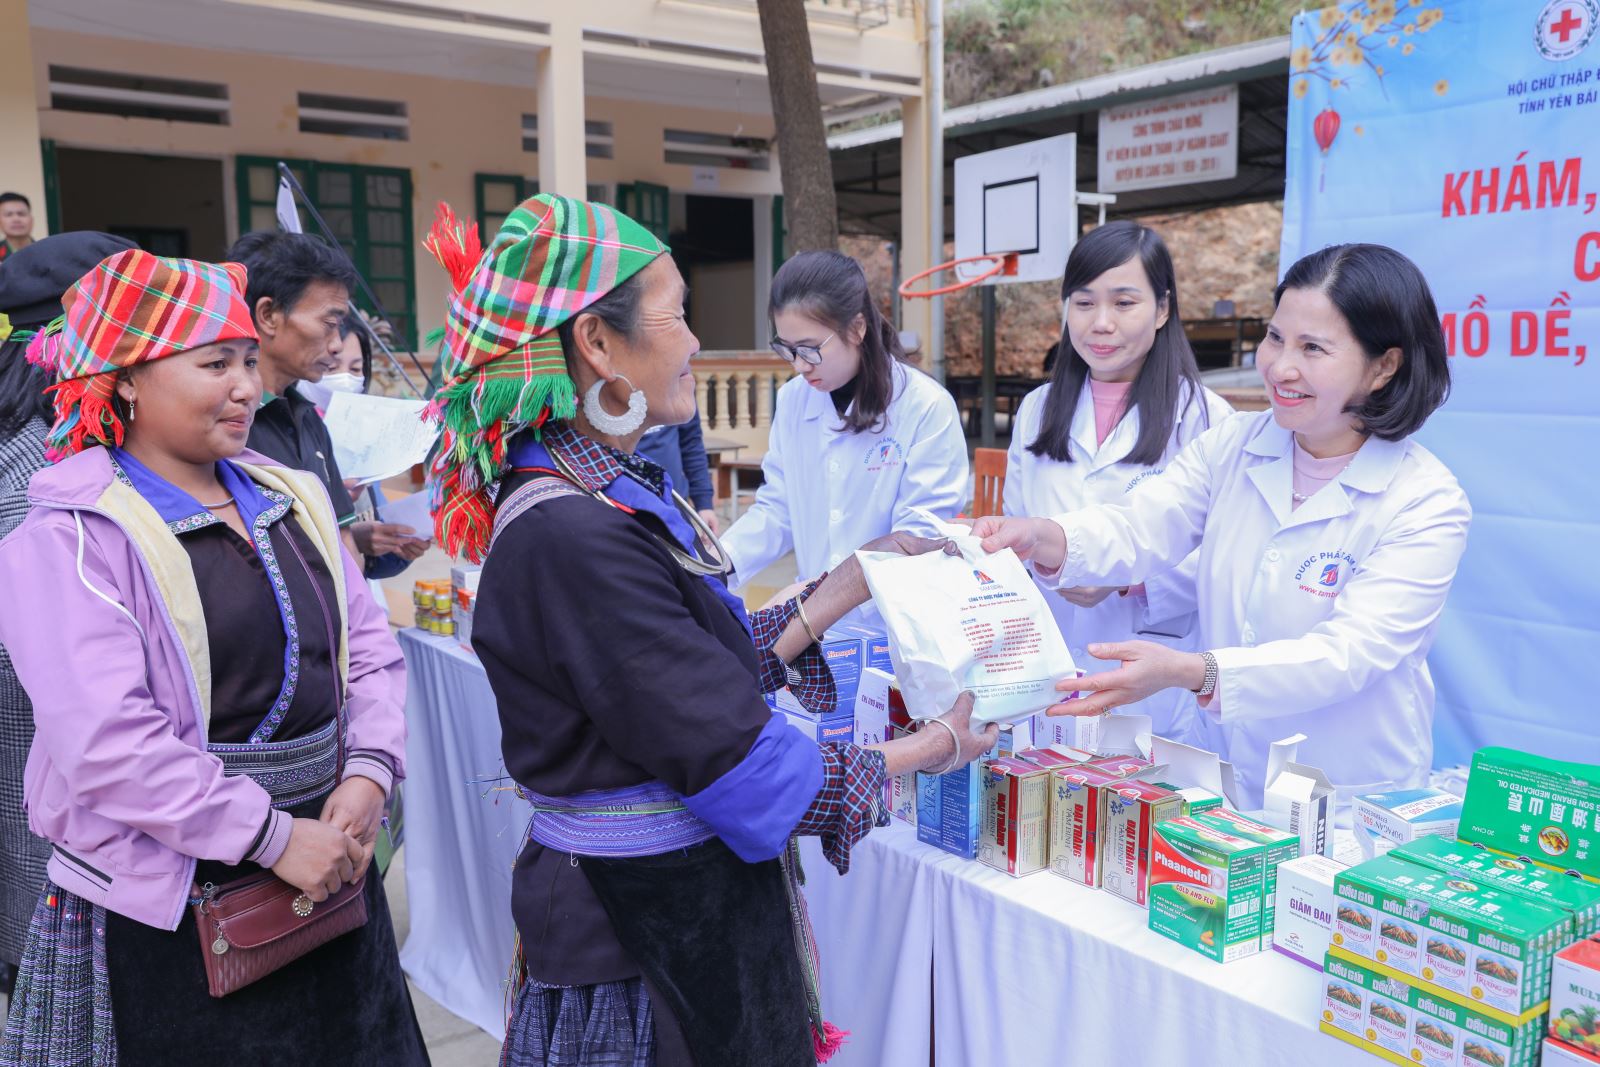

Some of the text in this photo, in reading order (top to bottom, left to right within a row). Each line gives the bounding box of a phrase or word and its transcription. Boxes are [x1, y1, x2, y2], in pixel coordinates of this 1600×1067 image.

[1508, 80, 1527, 97] HỘI
[1531, 74, 1556, 92] CHỮ
[1560, 68, 1592, 88] THẬP
[1549, 93, 1573, 109] YÊN
[1441, 150, 1597, 218] KHÁM,
[1510, 291, 1587, 366] DỀ,
[1073, 803, 1084, 858] ĐẠI TRÀNG
[1125, 819, 1136, 876] ĐẠI TRÀNG
[1154, 851, 1213, 886] Phaanedol
[1190, 889, 1203, 901] AND
[1290, 897, 1312, 916] GIẢM
[1313, 908, 1331, 924] ĐAU
